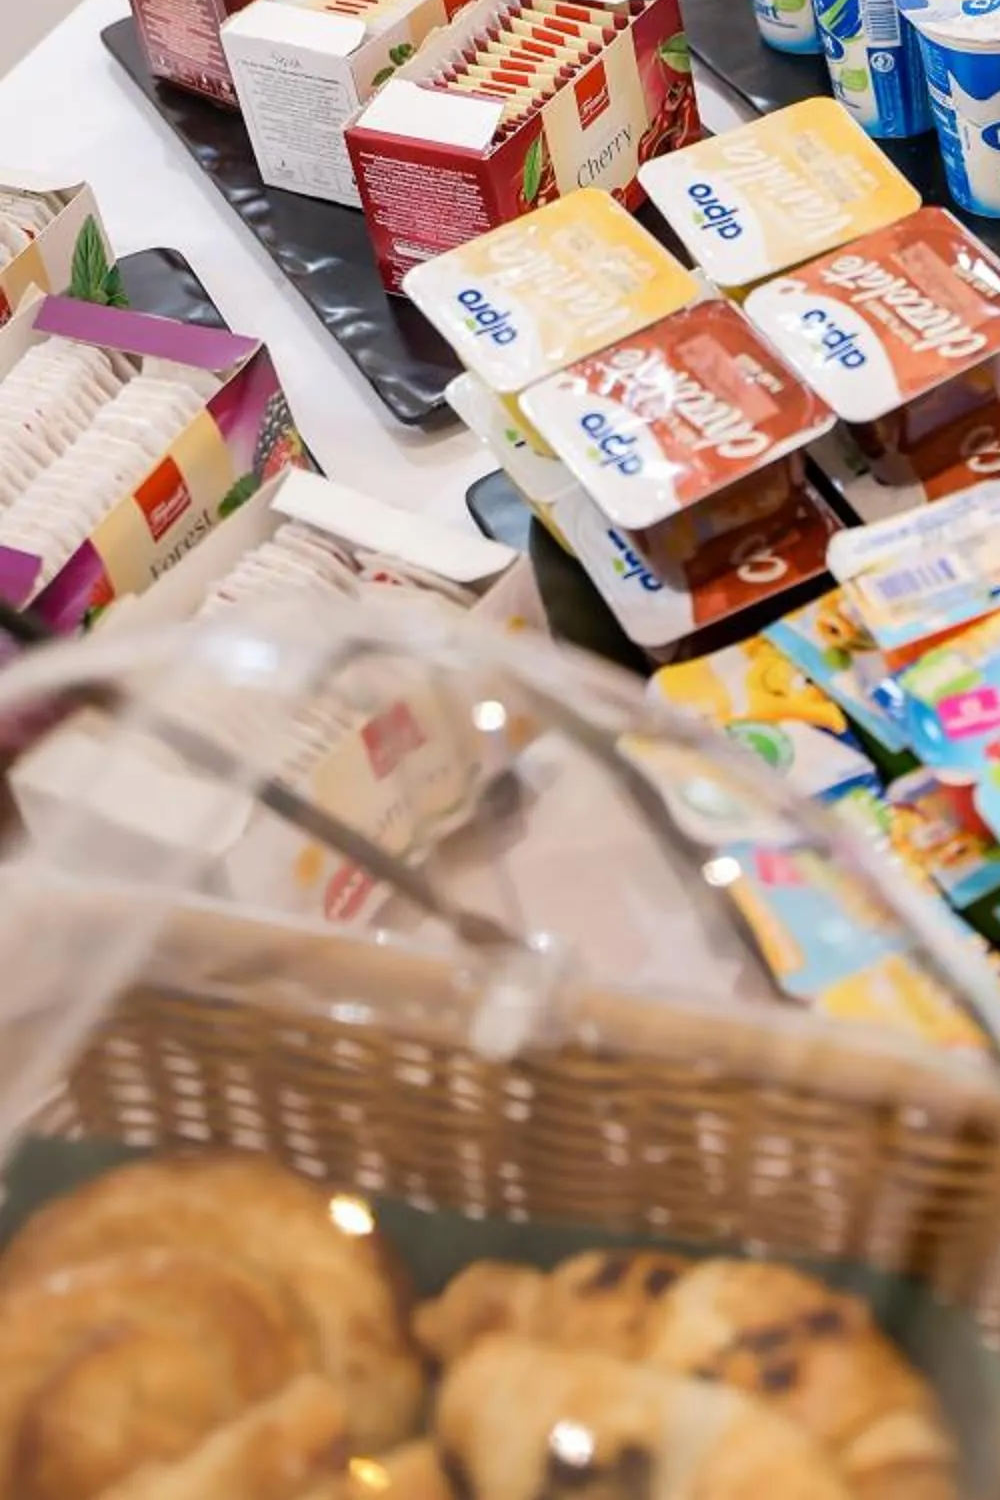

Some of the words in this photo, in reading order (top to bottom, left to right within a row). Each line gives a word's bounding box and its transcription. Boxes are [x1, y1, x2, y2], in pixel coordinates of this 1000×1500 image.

[577, 123, 631, 188] Cherry
[688, 183, 744, 240] alpro
[457, 289, 518, 346] alpro
[580, 412, 644, 476] alpro
